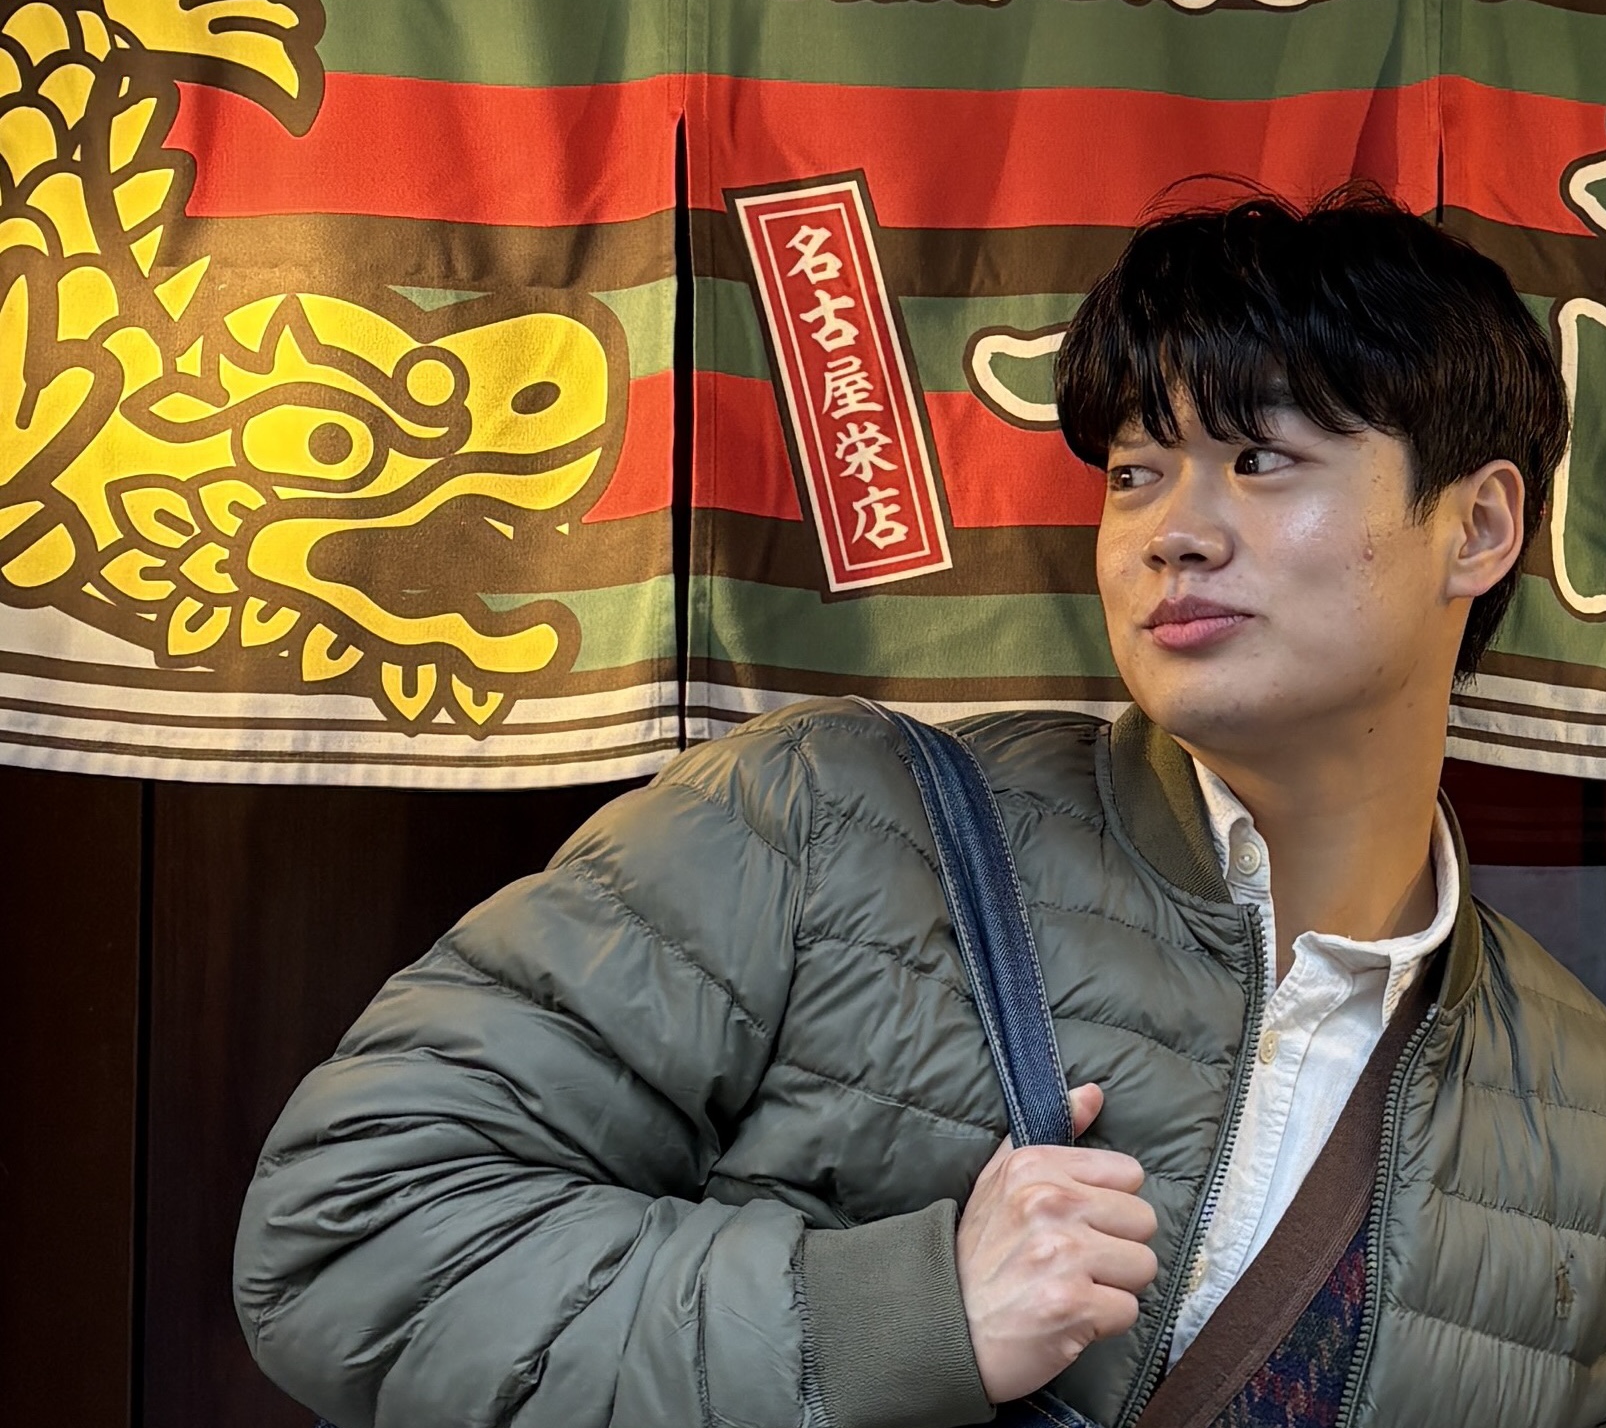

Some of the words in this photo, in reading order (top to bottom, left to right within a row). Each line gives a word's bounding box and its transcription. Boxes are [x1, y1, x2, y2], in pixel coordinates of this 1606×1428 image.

[785, 224, 909, 550] 名古屋栄店
